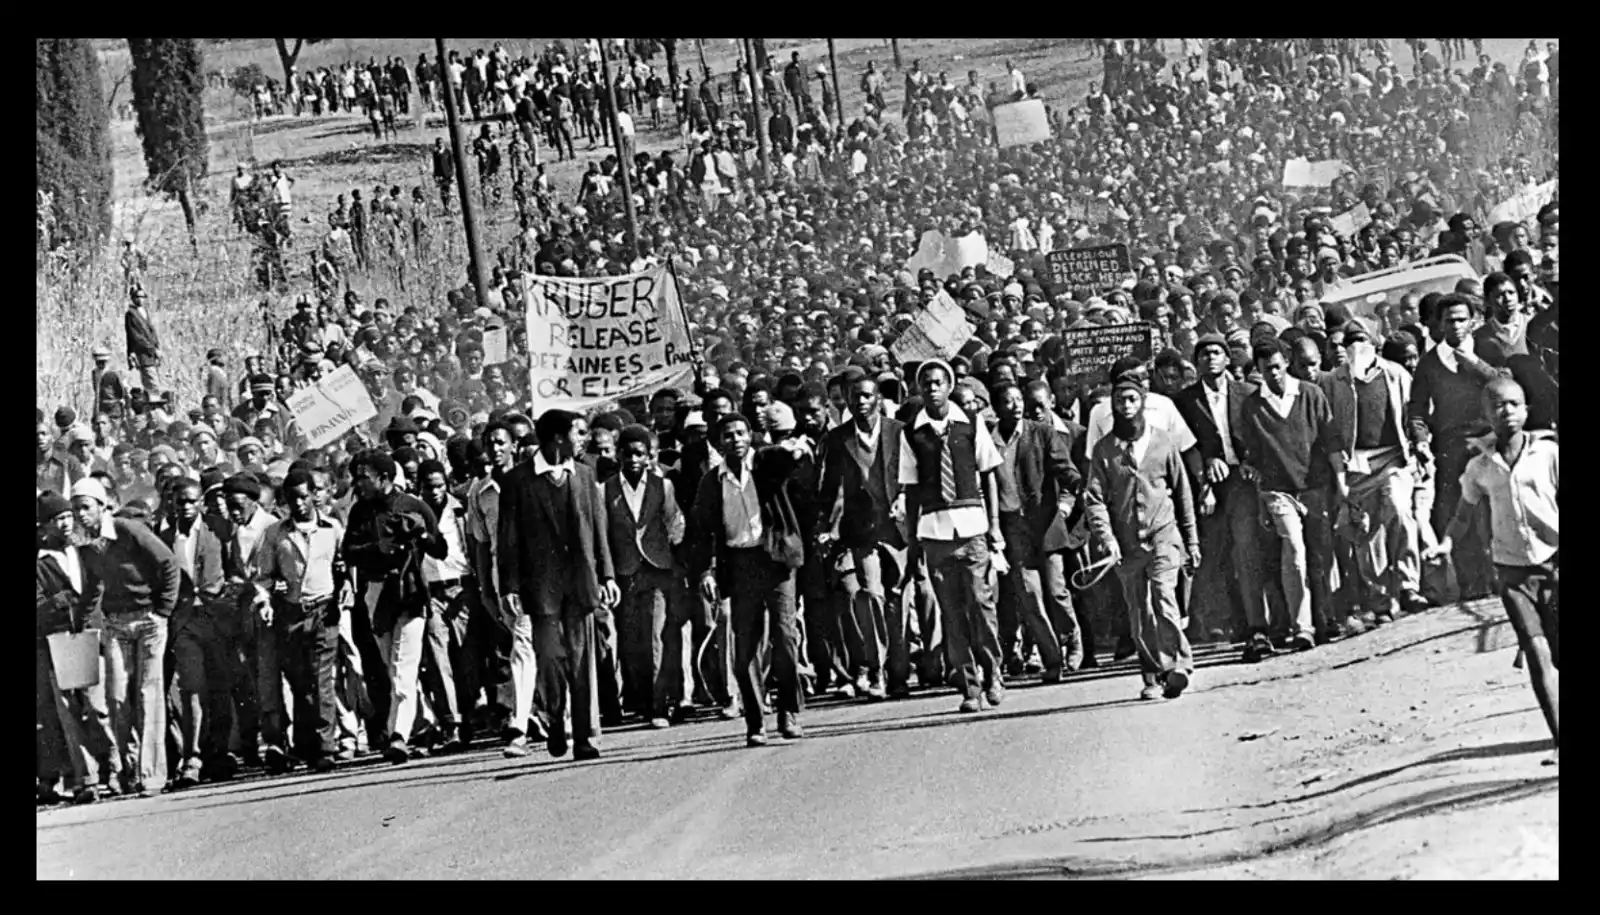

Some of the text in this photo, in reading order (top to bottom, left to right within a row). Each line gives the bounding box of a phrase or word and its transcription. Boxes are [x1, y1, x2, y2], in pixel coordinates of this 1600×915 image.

[1052, 259, 1119, 274] DETAINED
[1054, 272, 1093, 284] BLACK
[528, 276, 655, 319] KRUGER
[550, 317, 662, 350] RELEASE
[1124, 334, 1145, 342] AND
[1112, 344, 1134, 354] THE
[530, 353, 644, 375] DETAINEES
[537, 377, 573, 399] OR
